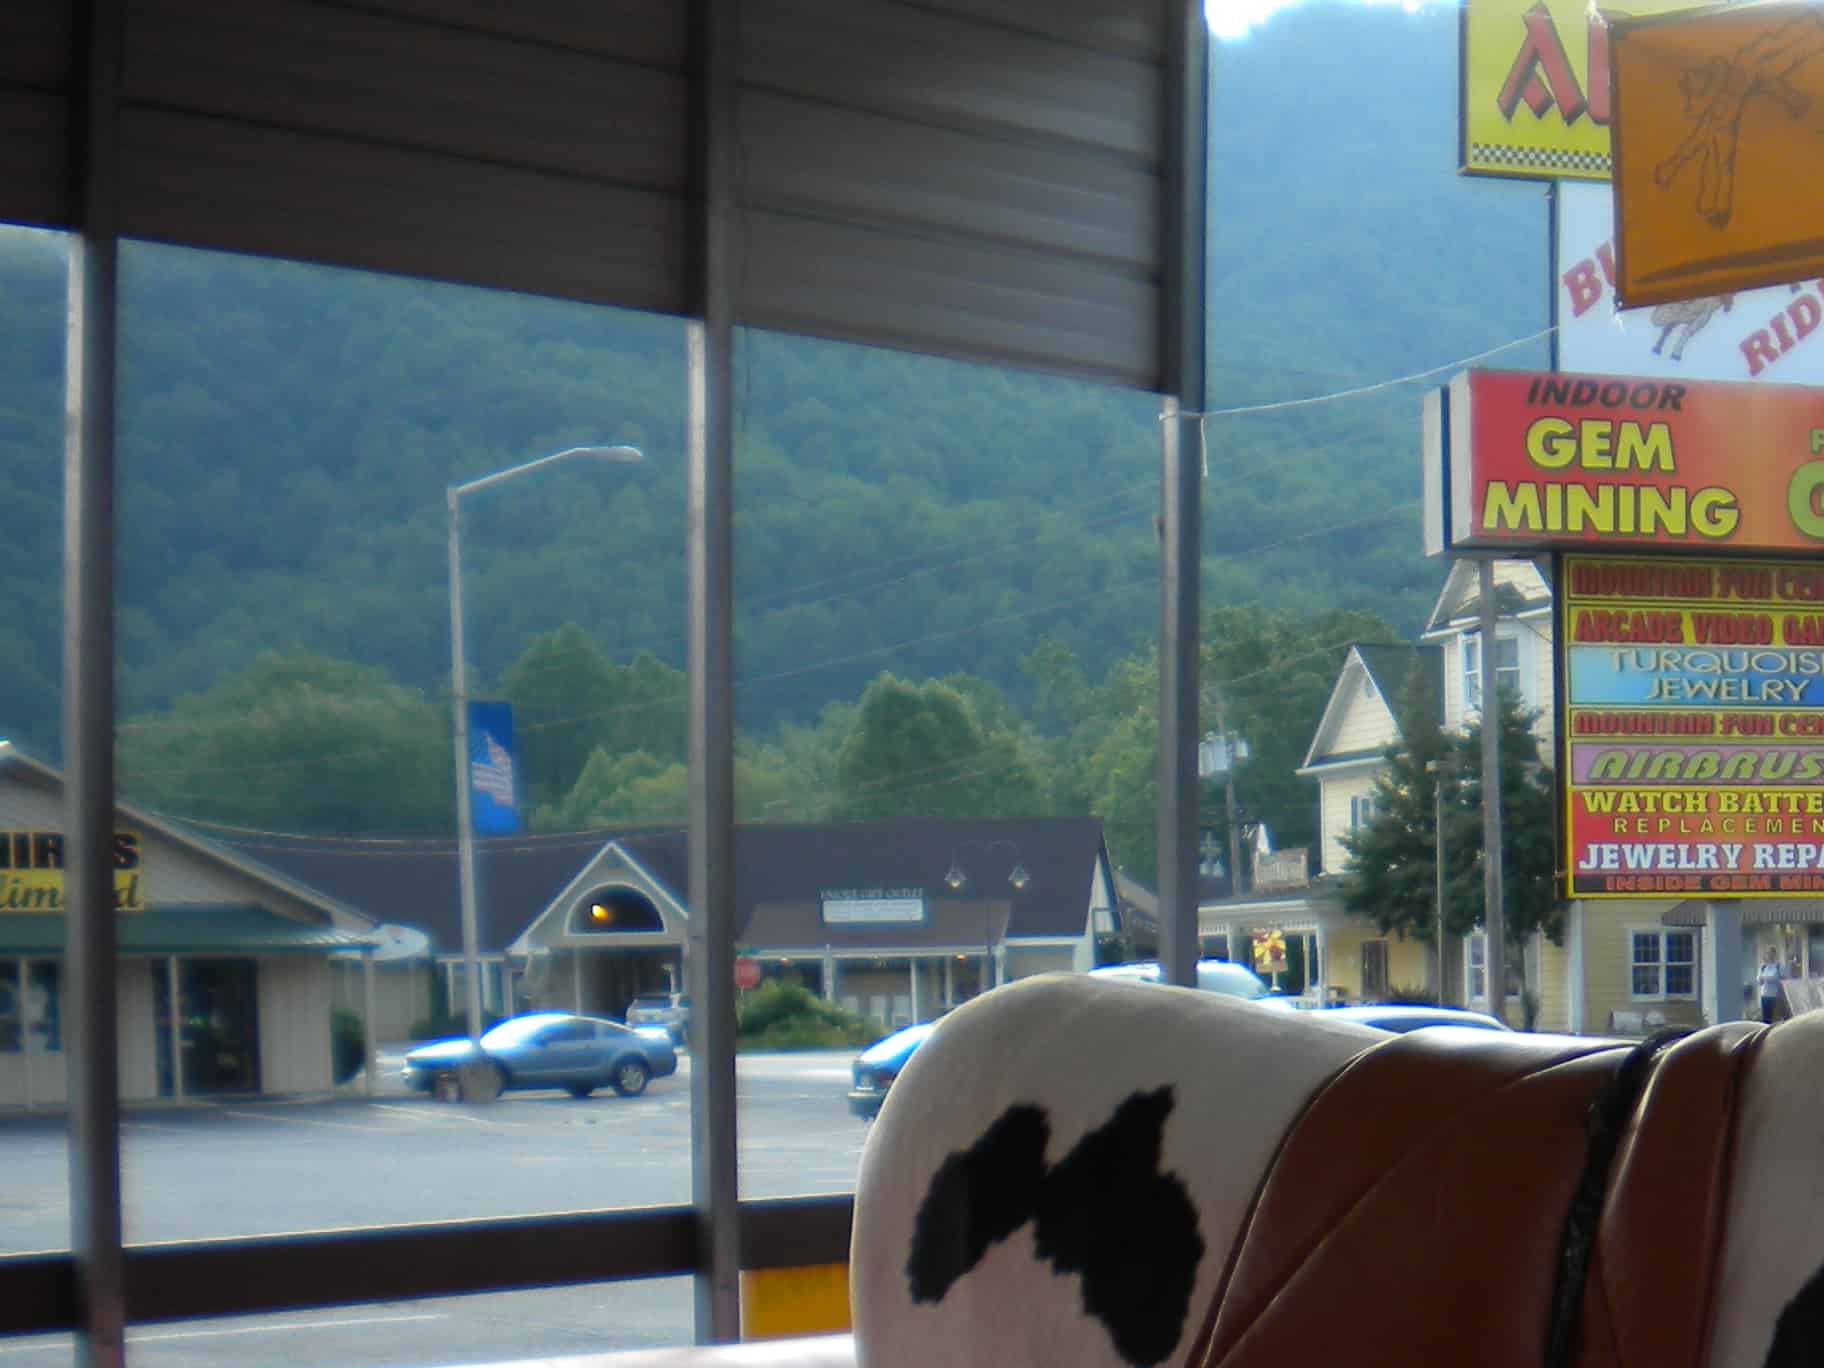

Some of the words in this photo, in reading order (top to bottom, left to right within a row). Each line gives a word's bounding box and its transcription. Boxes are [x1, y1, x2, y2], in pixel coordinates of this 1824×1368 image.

[1527, 377, 1686, 412] INDOOR
[1525, 416, 1676, 471] GEM
[1481, 480, 1741, 539] MINING
[1574, 609, 1684, 643] ARCADE
[1692, 612, 1773, 646] VIDEO
[1647, 678, 1810, 702] JEWELRY
[1720, 714, 1774, 737] FUN
[1582, 791, 1709, 814] WATCH
[1579, 843, 1744, 871] JEWELRY
[1605, 875, 1702, 891] INSIDE
[1710, 874, 1770, 891] GEM
